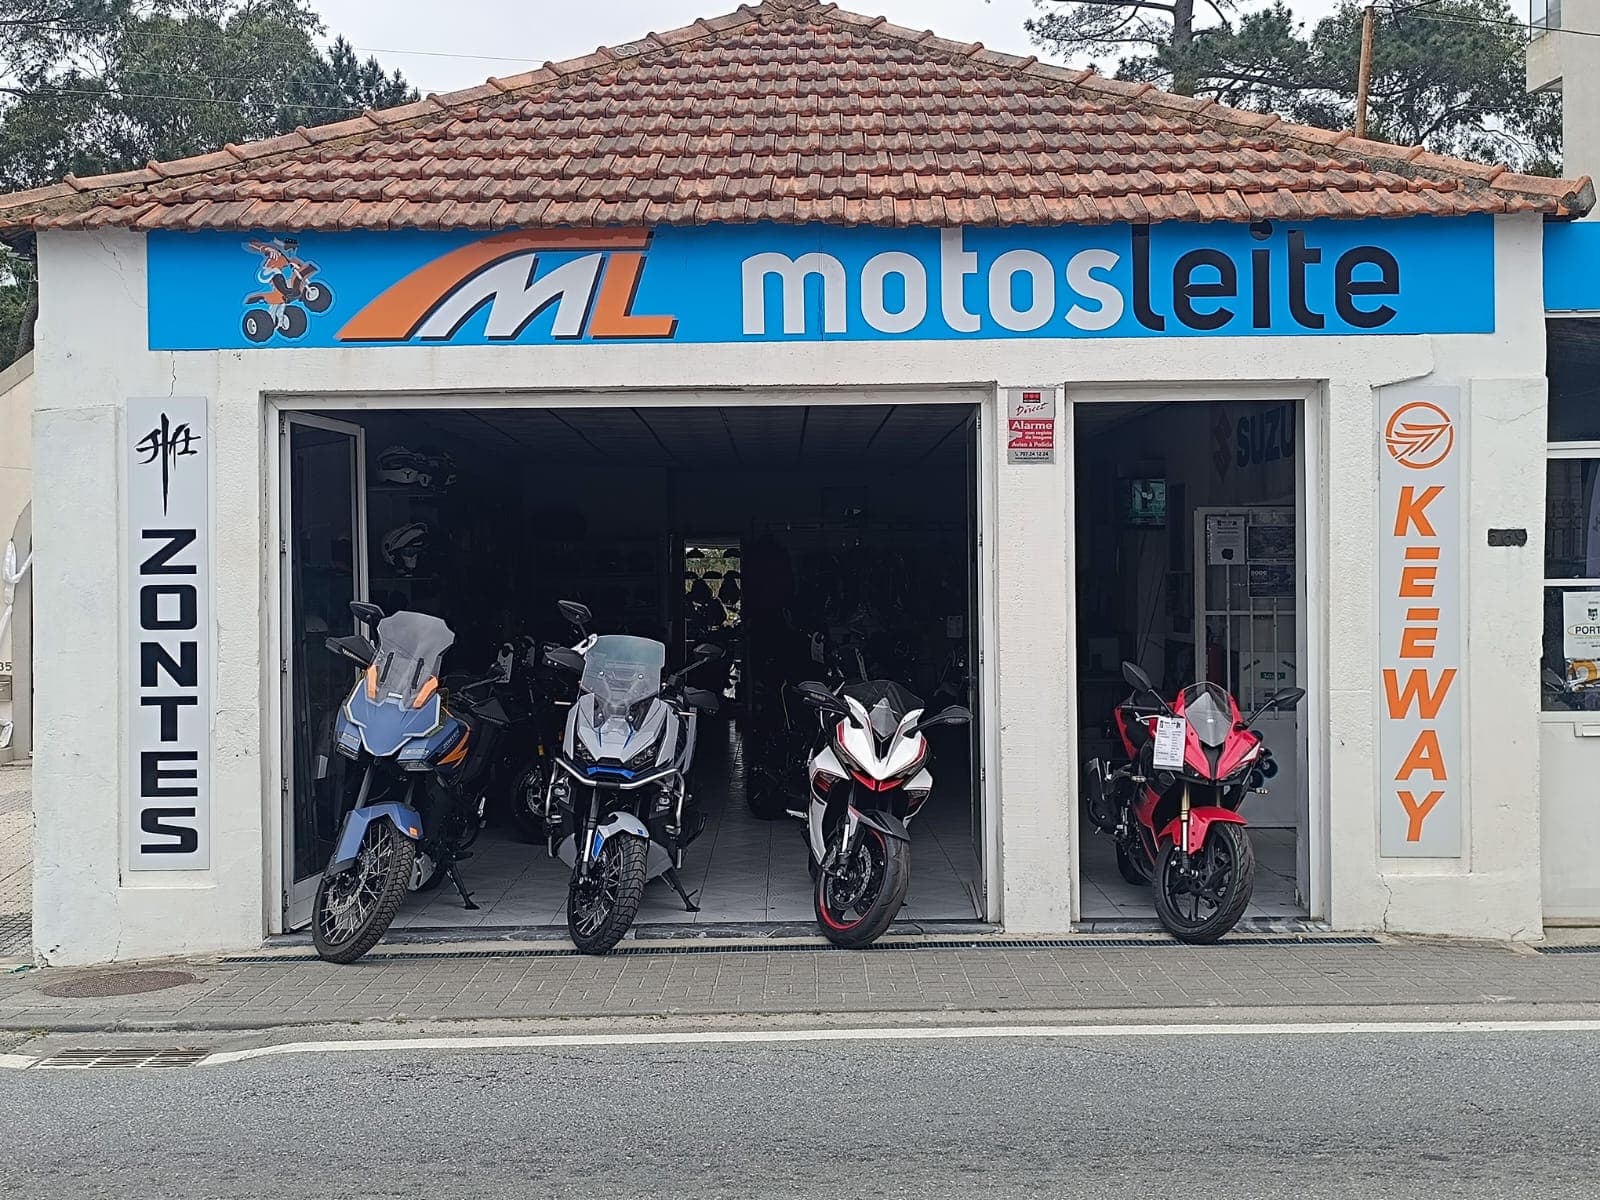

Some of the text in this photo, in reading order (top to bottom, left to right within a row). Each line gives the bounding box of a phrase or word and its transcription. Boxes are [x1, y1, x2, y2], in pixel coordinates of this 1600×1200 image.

[1011, 420, 1053, 430] Alarme
[1237, 406, 1296, 468] SUZU
[140, 529, 198, 854] ZONTES
[1382, 486, 1457, 842] KEEWAY
